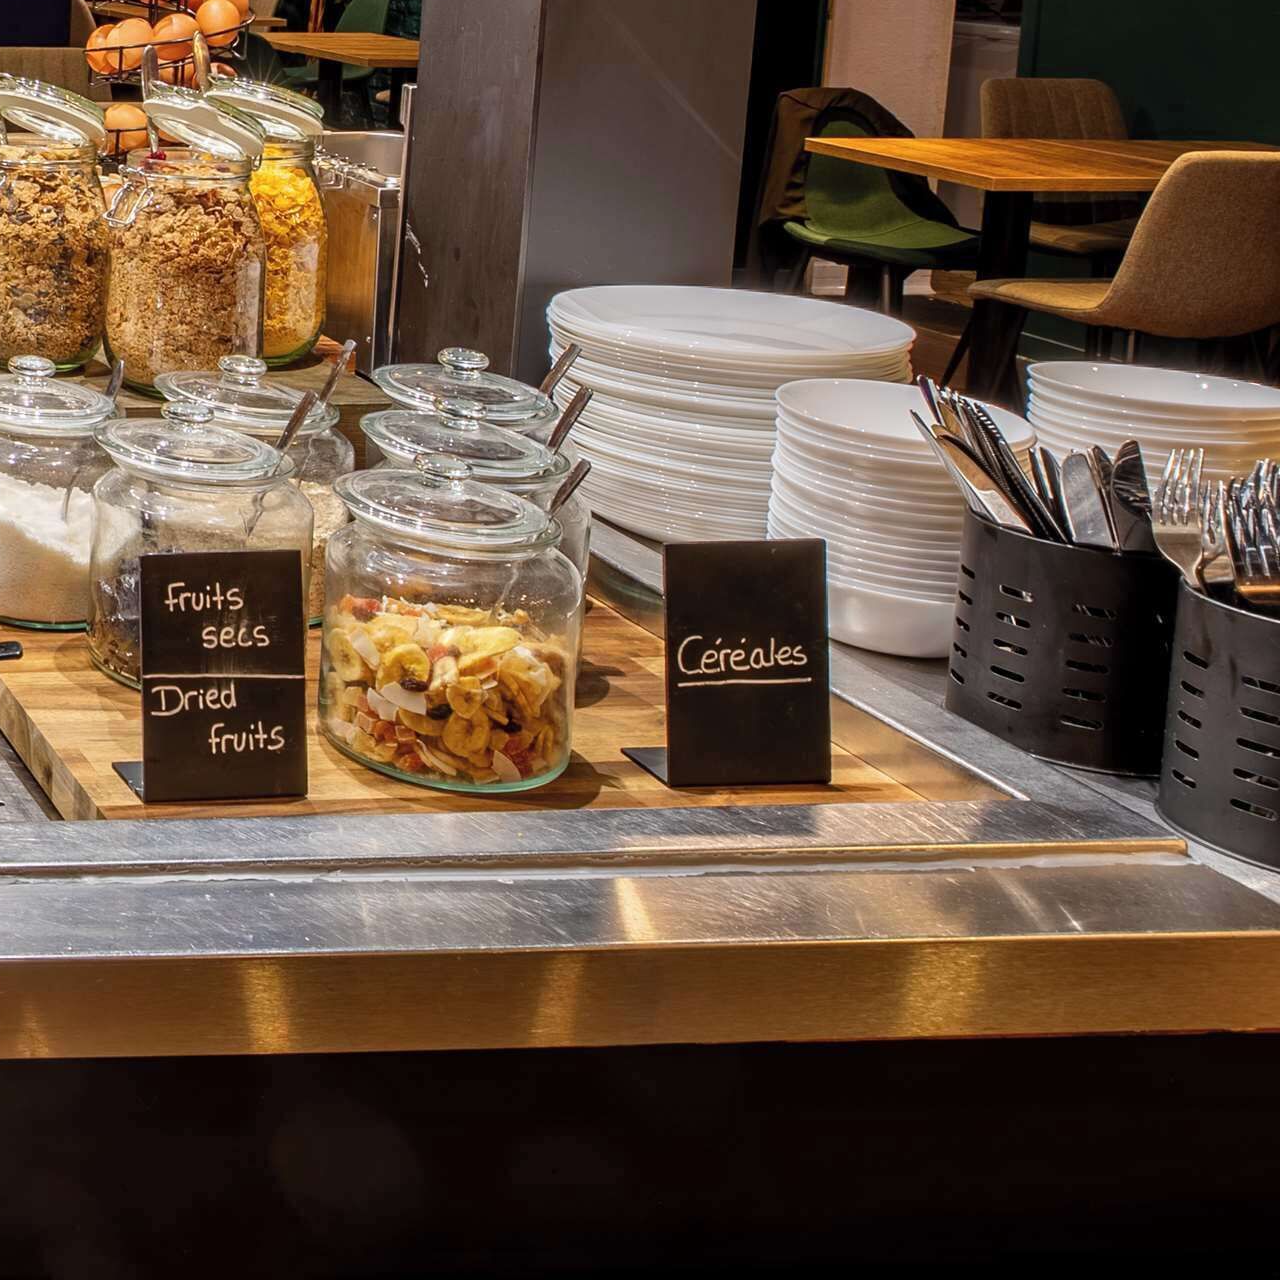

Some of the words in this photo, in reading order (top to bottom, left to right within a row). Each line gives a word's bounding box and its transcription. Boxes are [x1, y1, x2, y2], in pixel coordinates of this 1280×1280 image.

[201, 625, 270, 649] secs
[677, 635, 808, 674] Céréales
[151, 681, 237, 716] Dried
